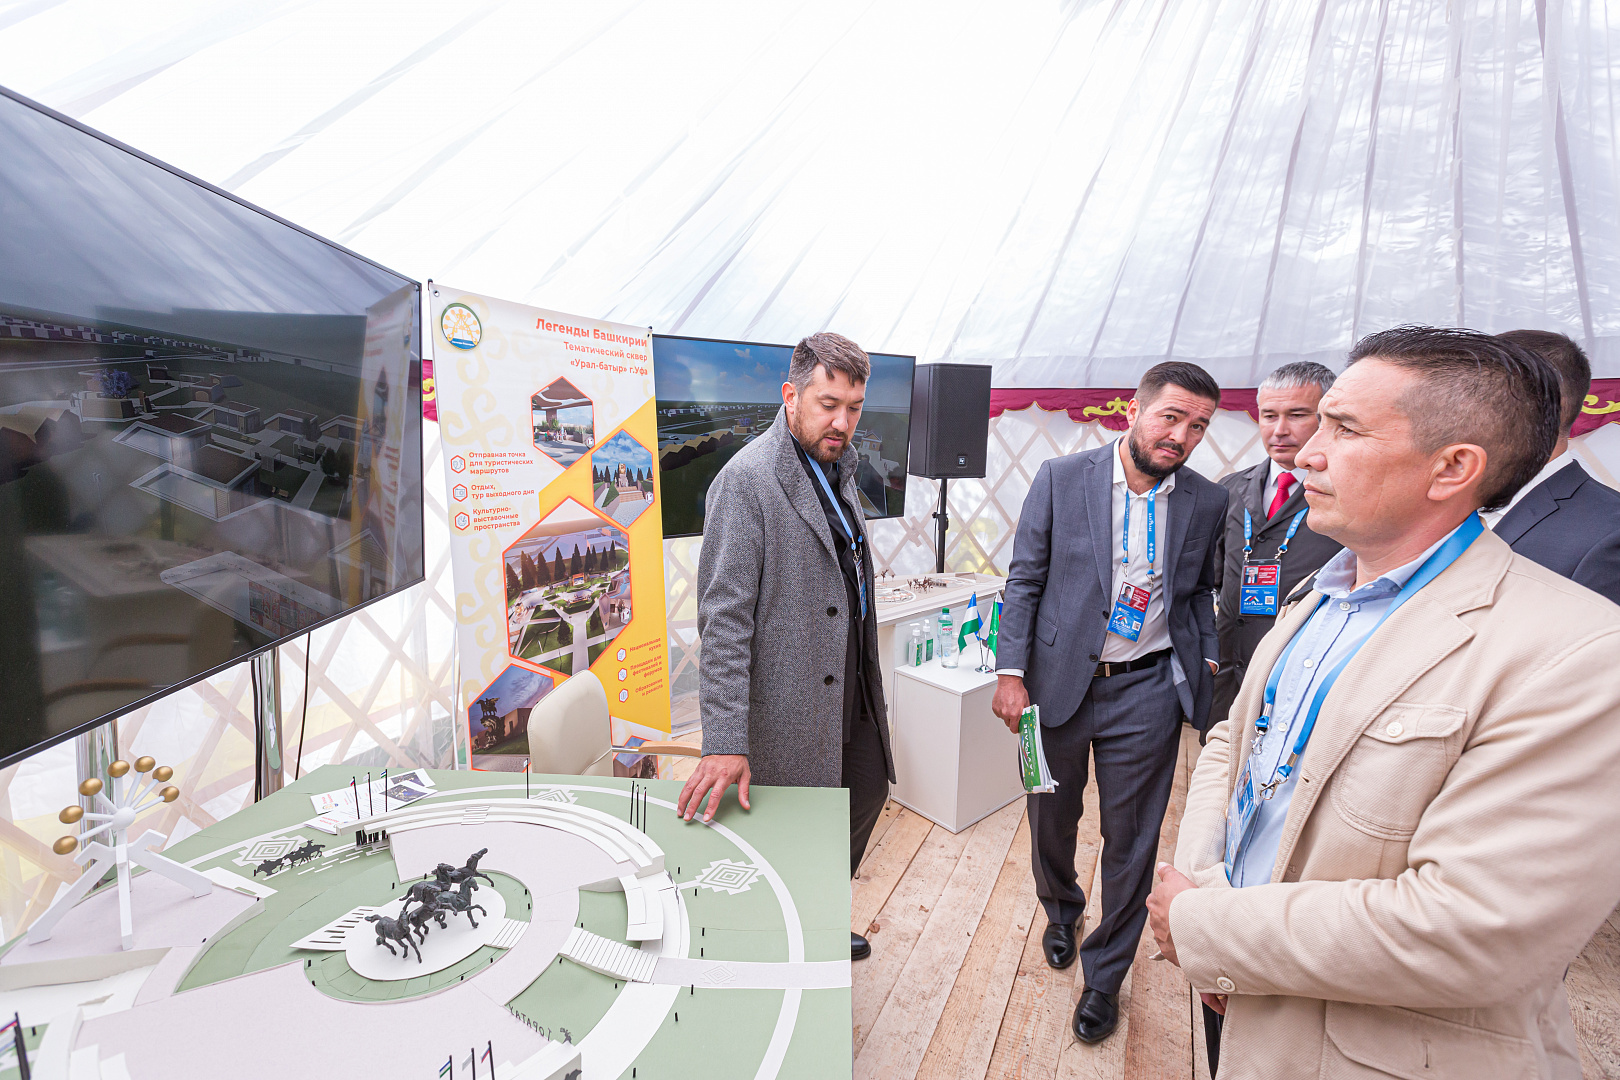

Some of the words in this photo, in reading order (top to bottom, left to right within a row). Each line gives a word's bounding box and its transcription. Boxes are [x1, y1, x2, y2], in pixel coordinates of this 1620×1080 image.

[536, 318, 590, 338] Легенды
[593, 328, 647, 347] Башкирии
[563, 341, 624, 359] Тематический
[626, 351, 648, 362] сквер
[570, 358, 627, 374] «Урал-батыр»
[629, 366, 648, 376] г.Уфа
[486, 490, 521, 498] выходного
[473, 506, 511, 516] Культурно-
[473, 513, 519, 523] выставочные
[474, 521, 520, 531] пространства
